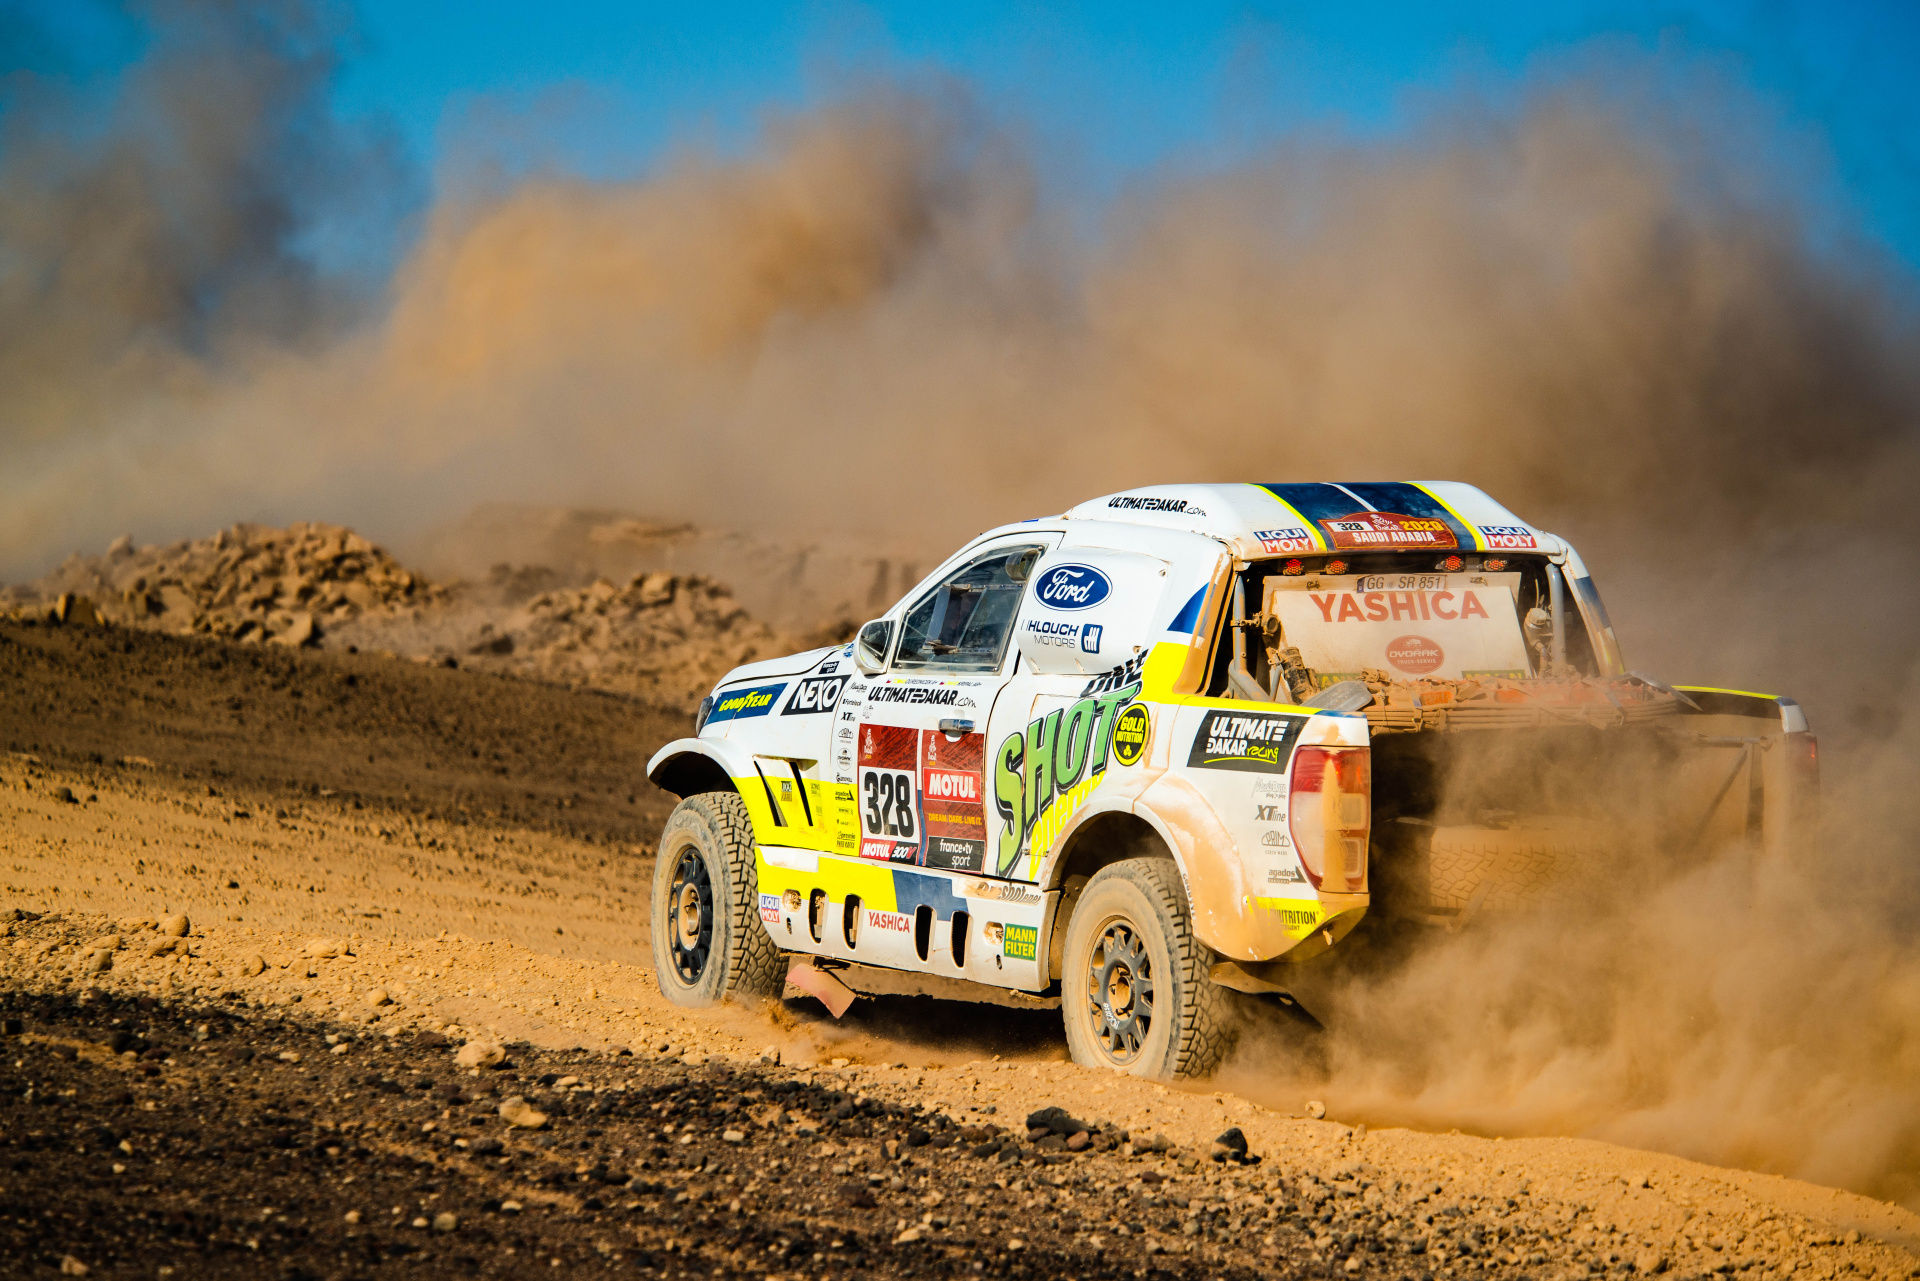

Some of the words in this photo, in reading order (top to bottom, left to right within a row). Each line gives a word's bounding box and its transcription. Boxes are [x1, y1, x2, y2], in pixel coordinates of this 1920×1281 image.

[1257, 529, 1306, 540] LIQUI
[1337, 522, 1365, 531] 328
[1399, 521, 1444, 531] 2020
[1480, 527, 1529, 535] LIQUI
[1264, 539, 1309, 552] MOLY
[1352, 532, 1390, 543] SAUDI
[1391, 532, 1436, 543] ARABIA
[1488, 535, 1532, 547] MOLY
[1044, 569, 1095, 603] Ford
[1367, 577, 1384, 590] GG
[1399, 576, 1415, 589] SR
[1419, 576, 1441, 589] 851
[1309, 591, 1489, 622] YASHICA
[1028, 620, 1079, 636] HLOUCH
[1034, 634, 1076, 648] MOTORS
[719, 691, 773, 712] GOODYEAR
[791, 678, 842, 712] NEXO
[1120, 716, 1145, 733] GOLD
[1209, 716, 1289, 742] ULTIMATE
[1206, 740, 1248, 757] DAKAR
[1246, 741, 1279, 759] racing
[929, 773, 976, 799] MOTUL
[995, 681, 1142, 878] SHOT
[864, 771, 914, 838] 328
[862, 843, 890, 858] MOTUL
[892, 846, 917, 860] 300V
[952, 855, 970, 870] sport
[1268, 868, 1295, 877] agados
[761, 896, 779, 909] LIQUI
[761, 909, 779, 922] MOLY
[868, 912, 910, 934] YASHICA
[1005, 926, 1037, 944] MANN
[1005, 941, 1036, 960] FILTER
